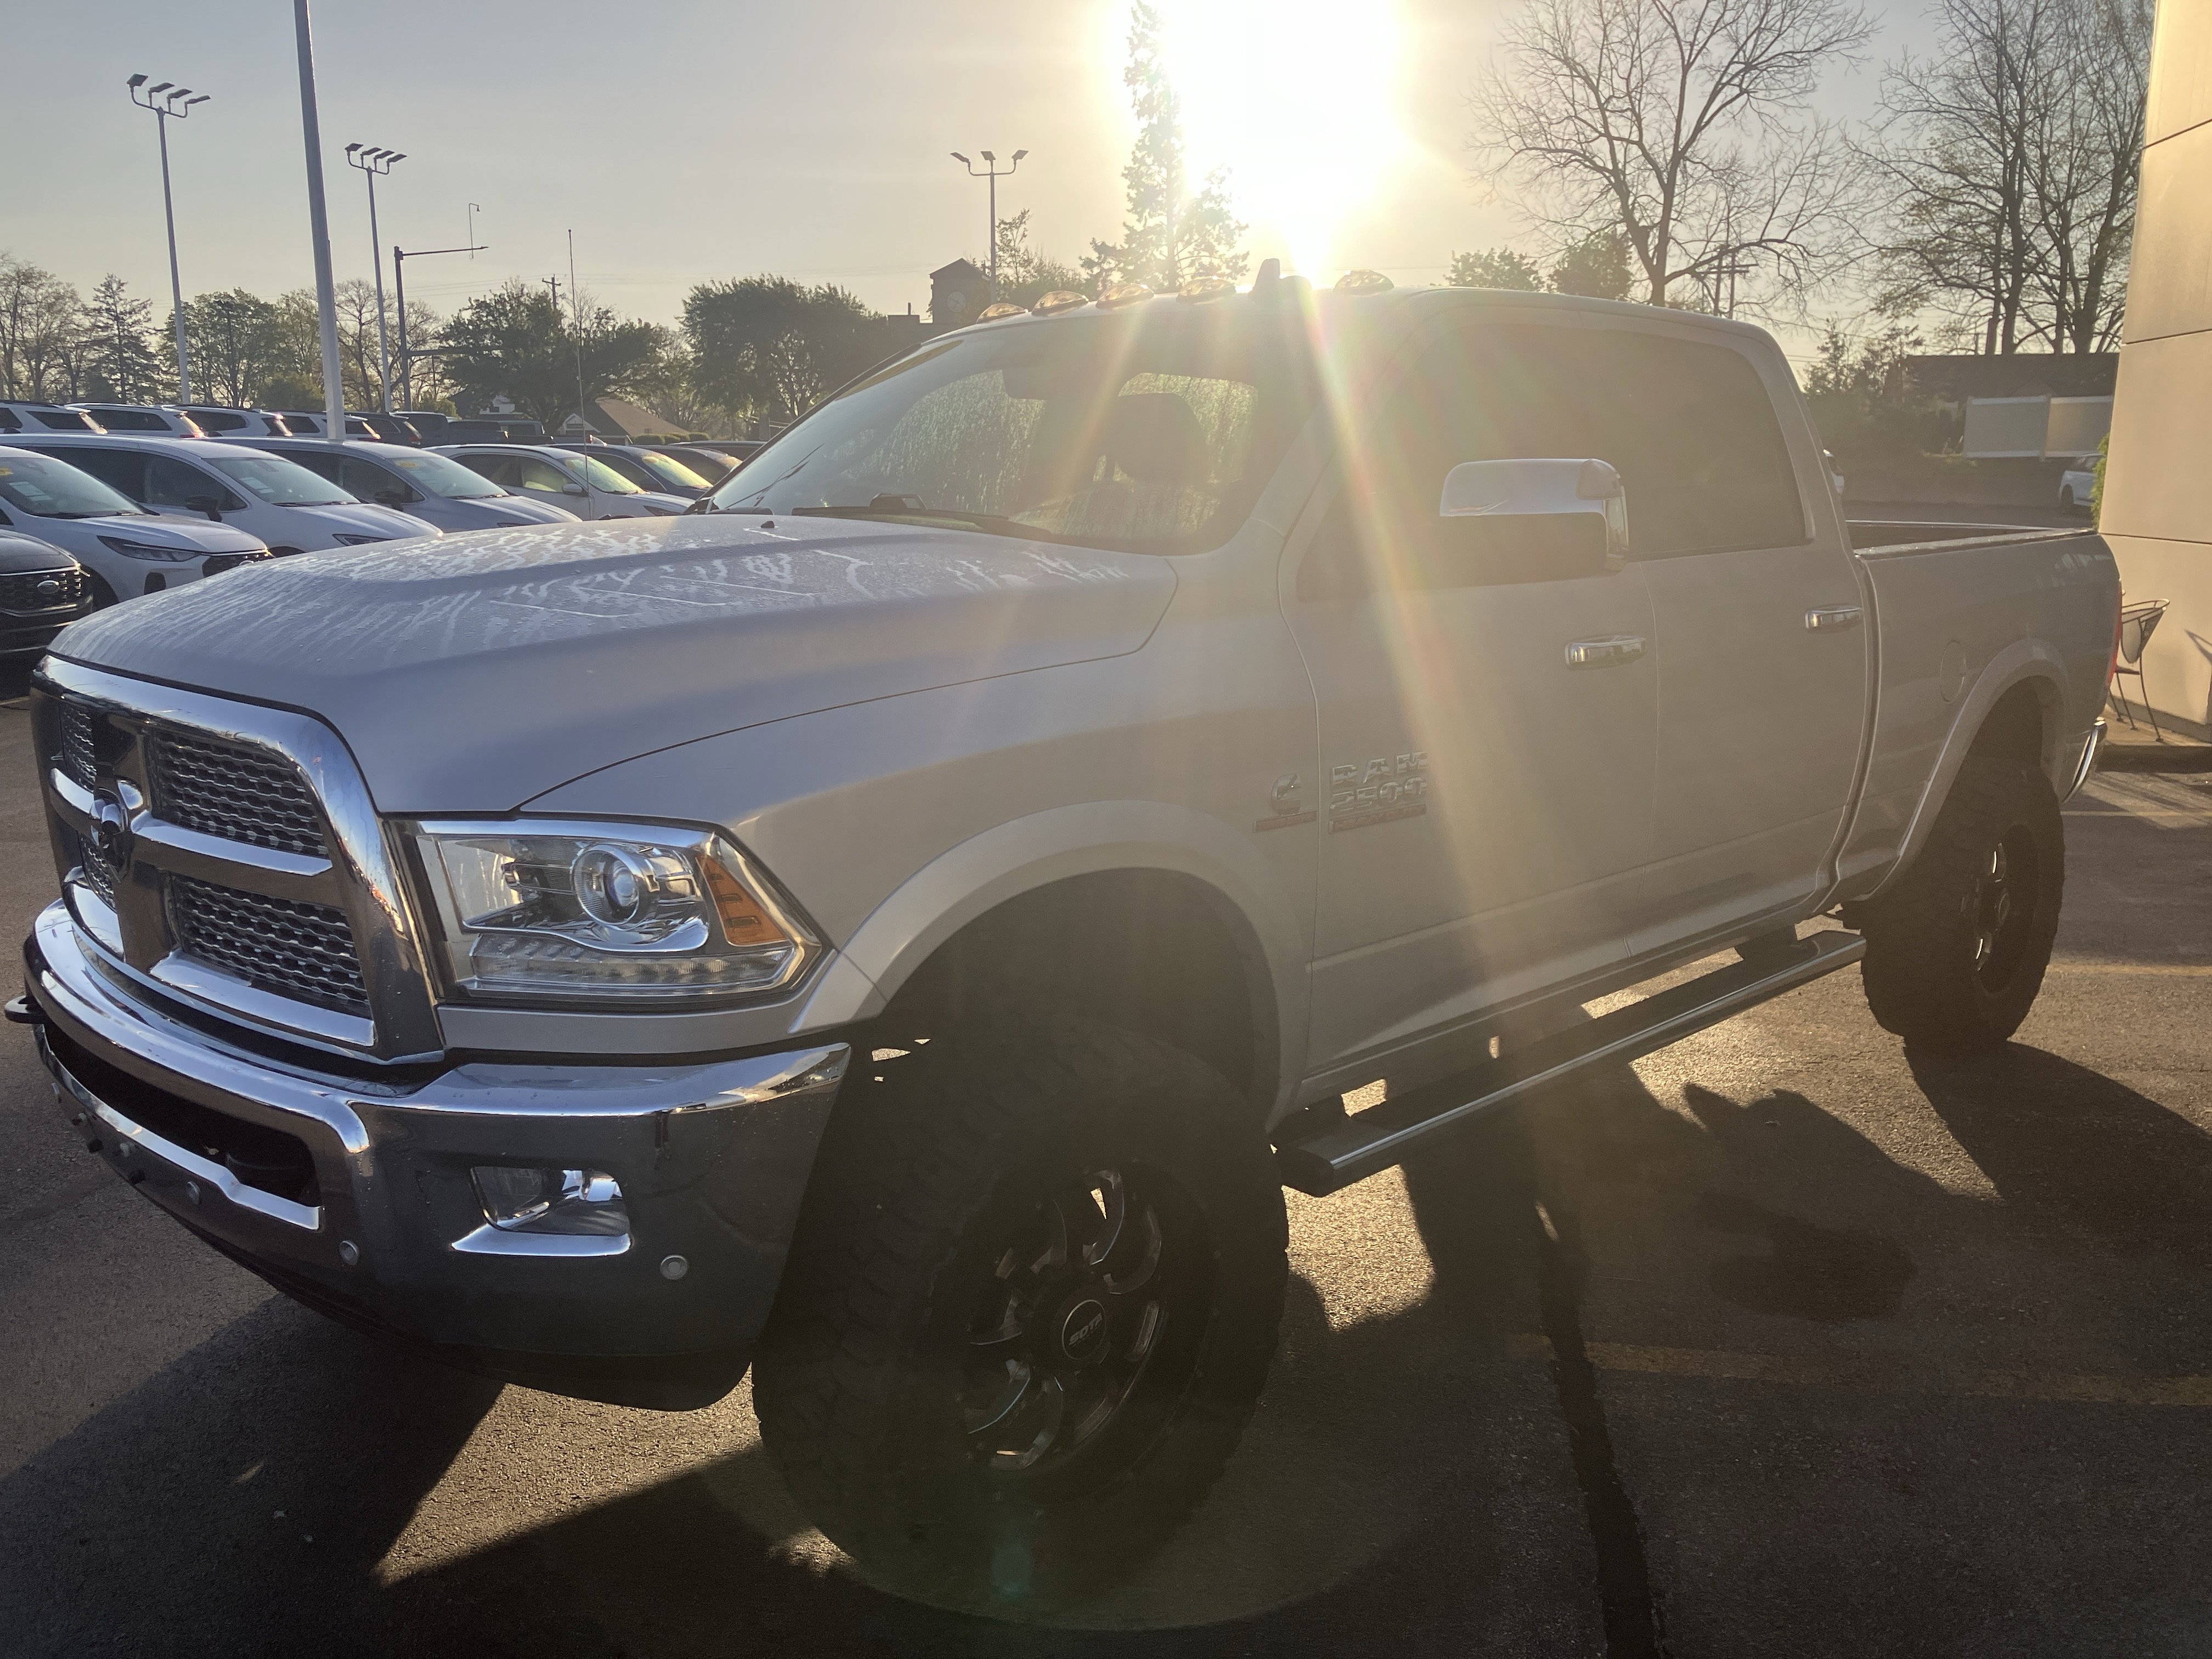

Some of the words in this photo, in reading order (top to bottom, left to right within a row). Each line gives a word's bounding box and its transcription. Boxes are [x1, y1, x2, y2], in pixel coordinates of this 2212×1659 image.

[1330, 752, 1427, 787] RAM
[1329, 777, 1427, 812] 2500
[1069, 1313, 1103, 1346] SOTA
